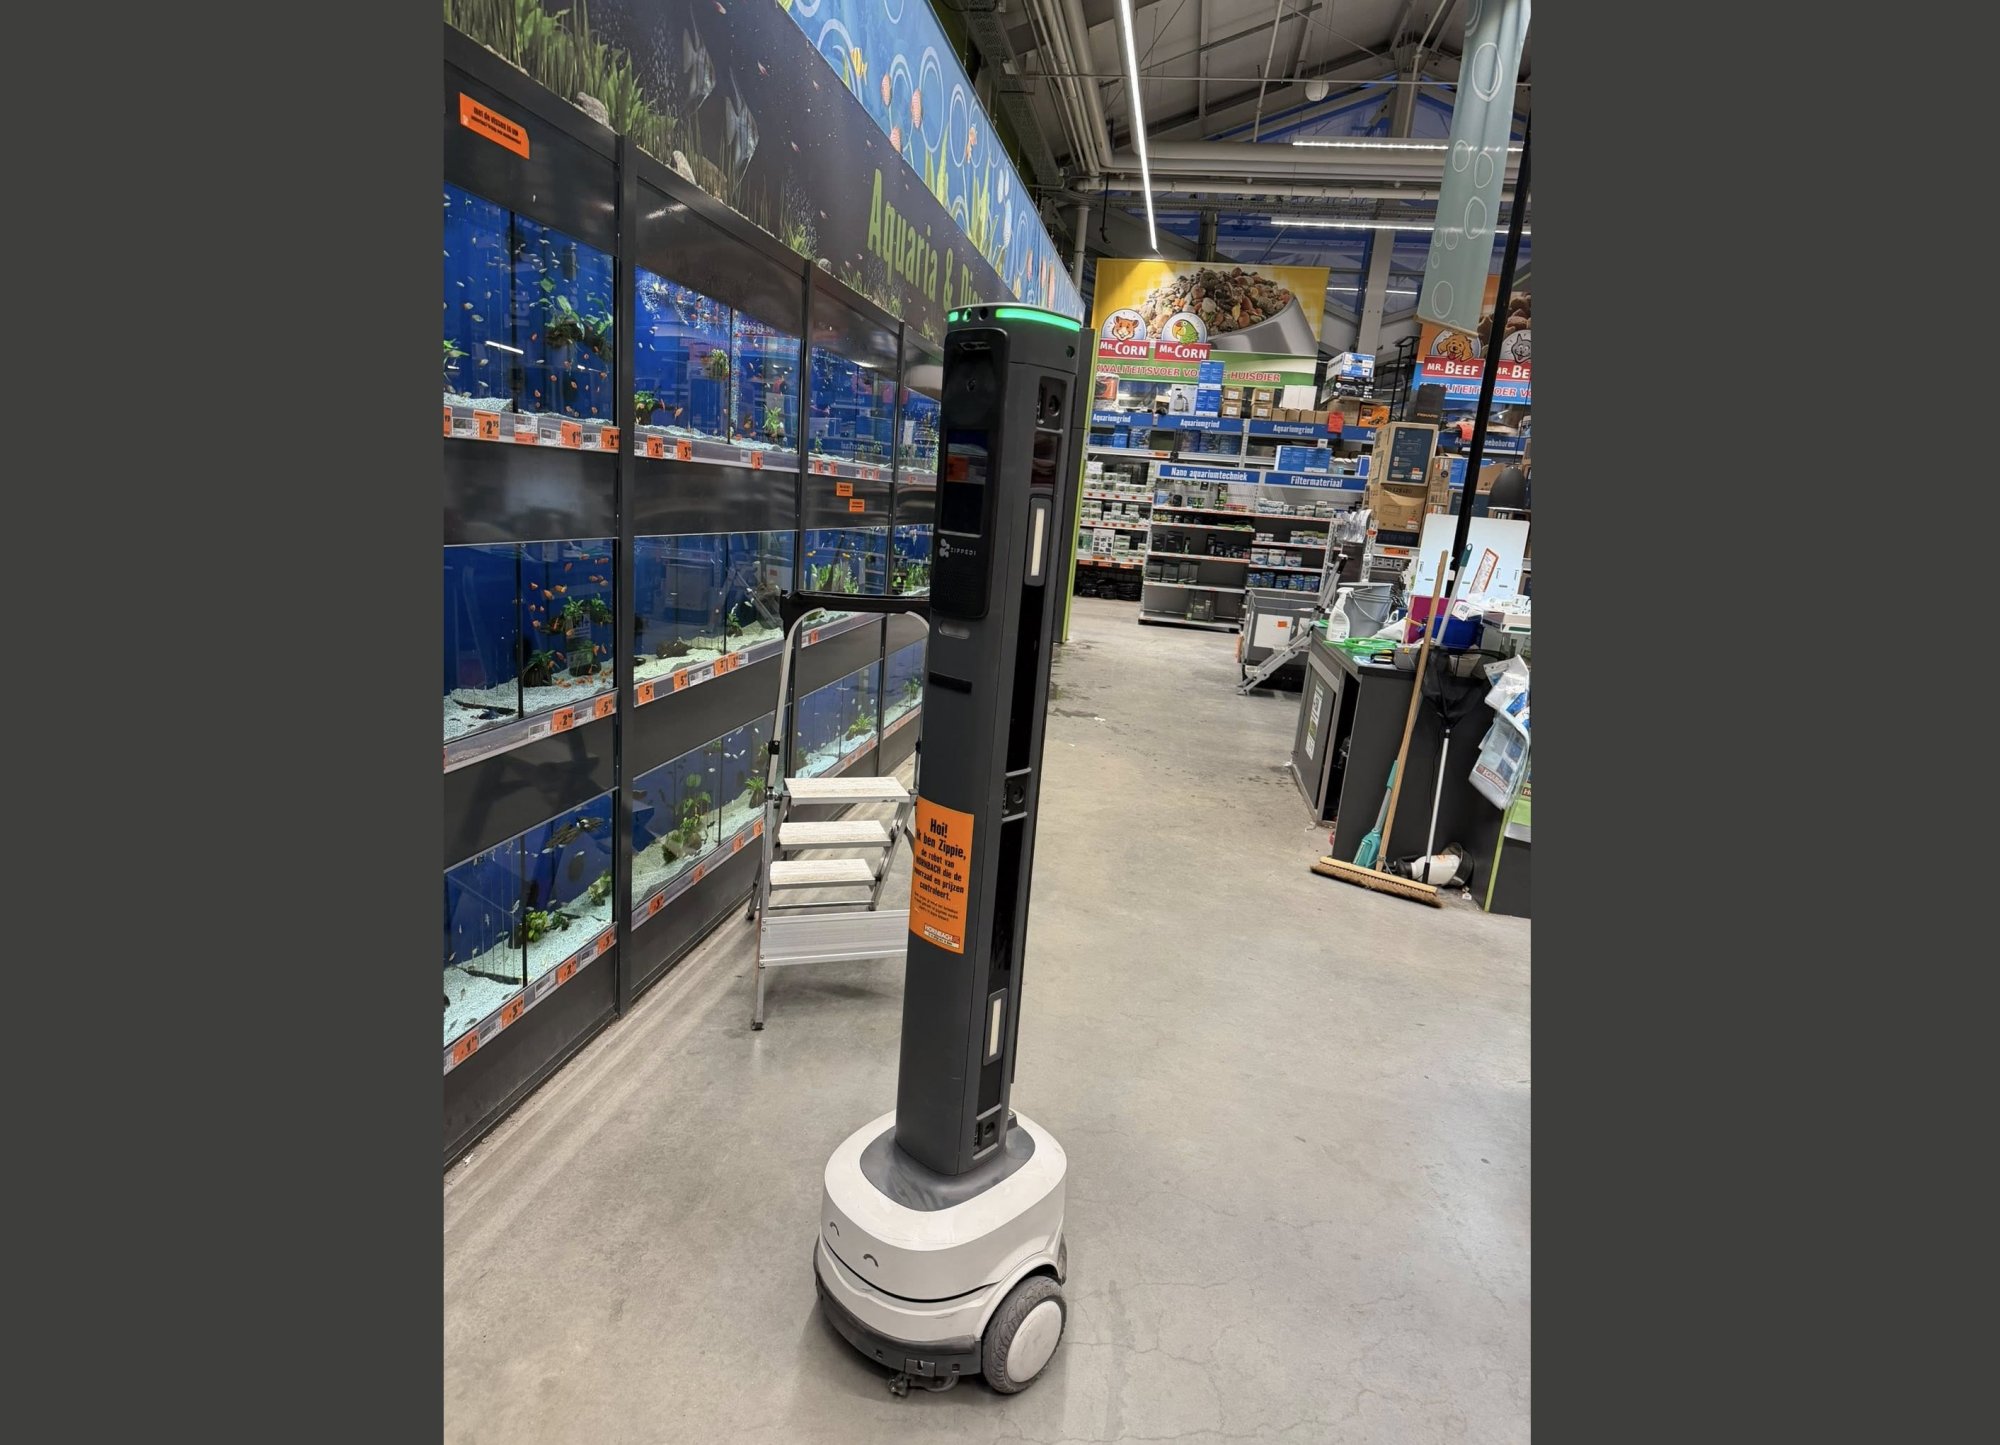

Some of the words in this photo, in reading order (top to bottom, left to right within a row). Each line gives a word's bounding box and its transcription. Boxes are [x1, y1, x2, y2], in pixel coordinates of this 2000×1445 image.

[867, 168, 938, 302] Aquaria
[943, 247, 954, 312] &
[1427, 362, 1444, 371] MR.
[1184, 368, 1199, 378] VO
[1230, 371, 1280, 382] HUISDIER
[1093, 413, 1132, 424] Aquariumgrind
[1180, 418, 1221, 429] Aquariumgrind
[1273, 424, 1315, 435] Aquariumgrind
[1171, 467, 1188, 477] Nano
[1189, 469, 1248, 482] aquariumtechniek
[1290, 475, 1343, 488] Filtermateriaal
[930, 818, 948, 838] Hoi!
[923, 832, 936, 848] ben
[938, 838, 966, 861] Zippie,
[921, 848, 927, 857] de
[928, 852, 942, 864] robot
[944, 859, 954, 869] van
[942, 868, 952, 879] die
[953, 872, 962, 882] de
[919, 881, 950, 901] controleert.
[934, 877, 940, 885] en
[942, 880, 964, 893] prijzen
